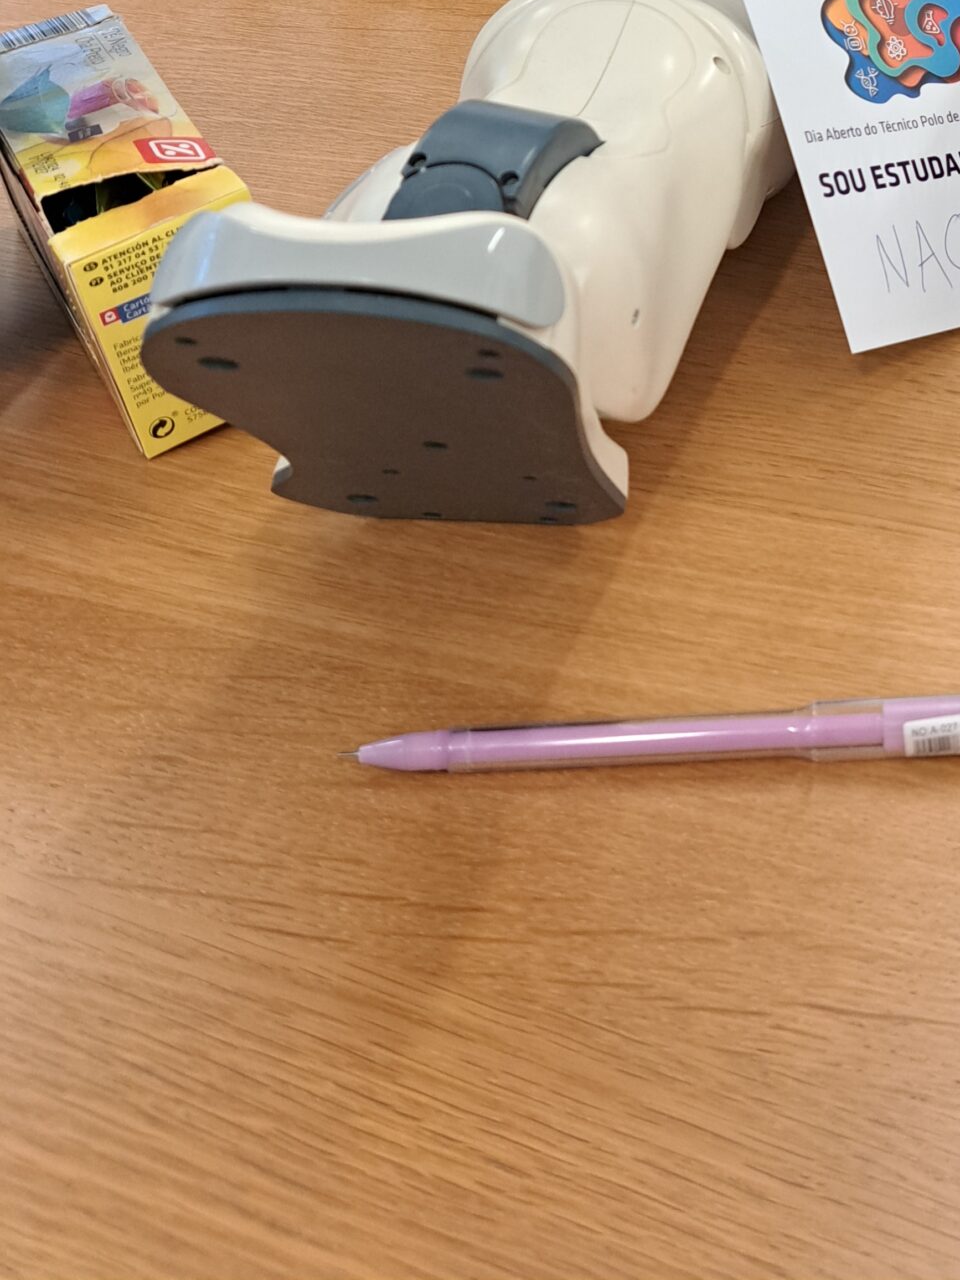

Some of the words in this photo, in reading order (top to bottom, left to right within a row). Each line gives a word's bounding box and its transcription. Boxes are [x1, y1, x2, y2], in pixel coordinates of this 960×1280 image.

[804, 129, 824, 144] Dia
[826, 125, 862, 142] Aberto
[864, 123, 878, 136] do
[879, 120, 919, 134] Técnico
[920, 113, 944, 129] Polo
[946, 110, 960, 124] de
[818, 167, 866, 198] SOU
[101, 239, 149, 266] ATENCIÓN
[151, 234, 164, 245] AL
[117, 255, 132, 267] 217
[134, 251, 146, 259] 04
[107, 259, 147, 280] SERVIÇO
[110, 276, 123, 288] AO
[125, 261, 158, 280] CLIENT
[123, 296, 150, 312] Cartó
